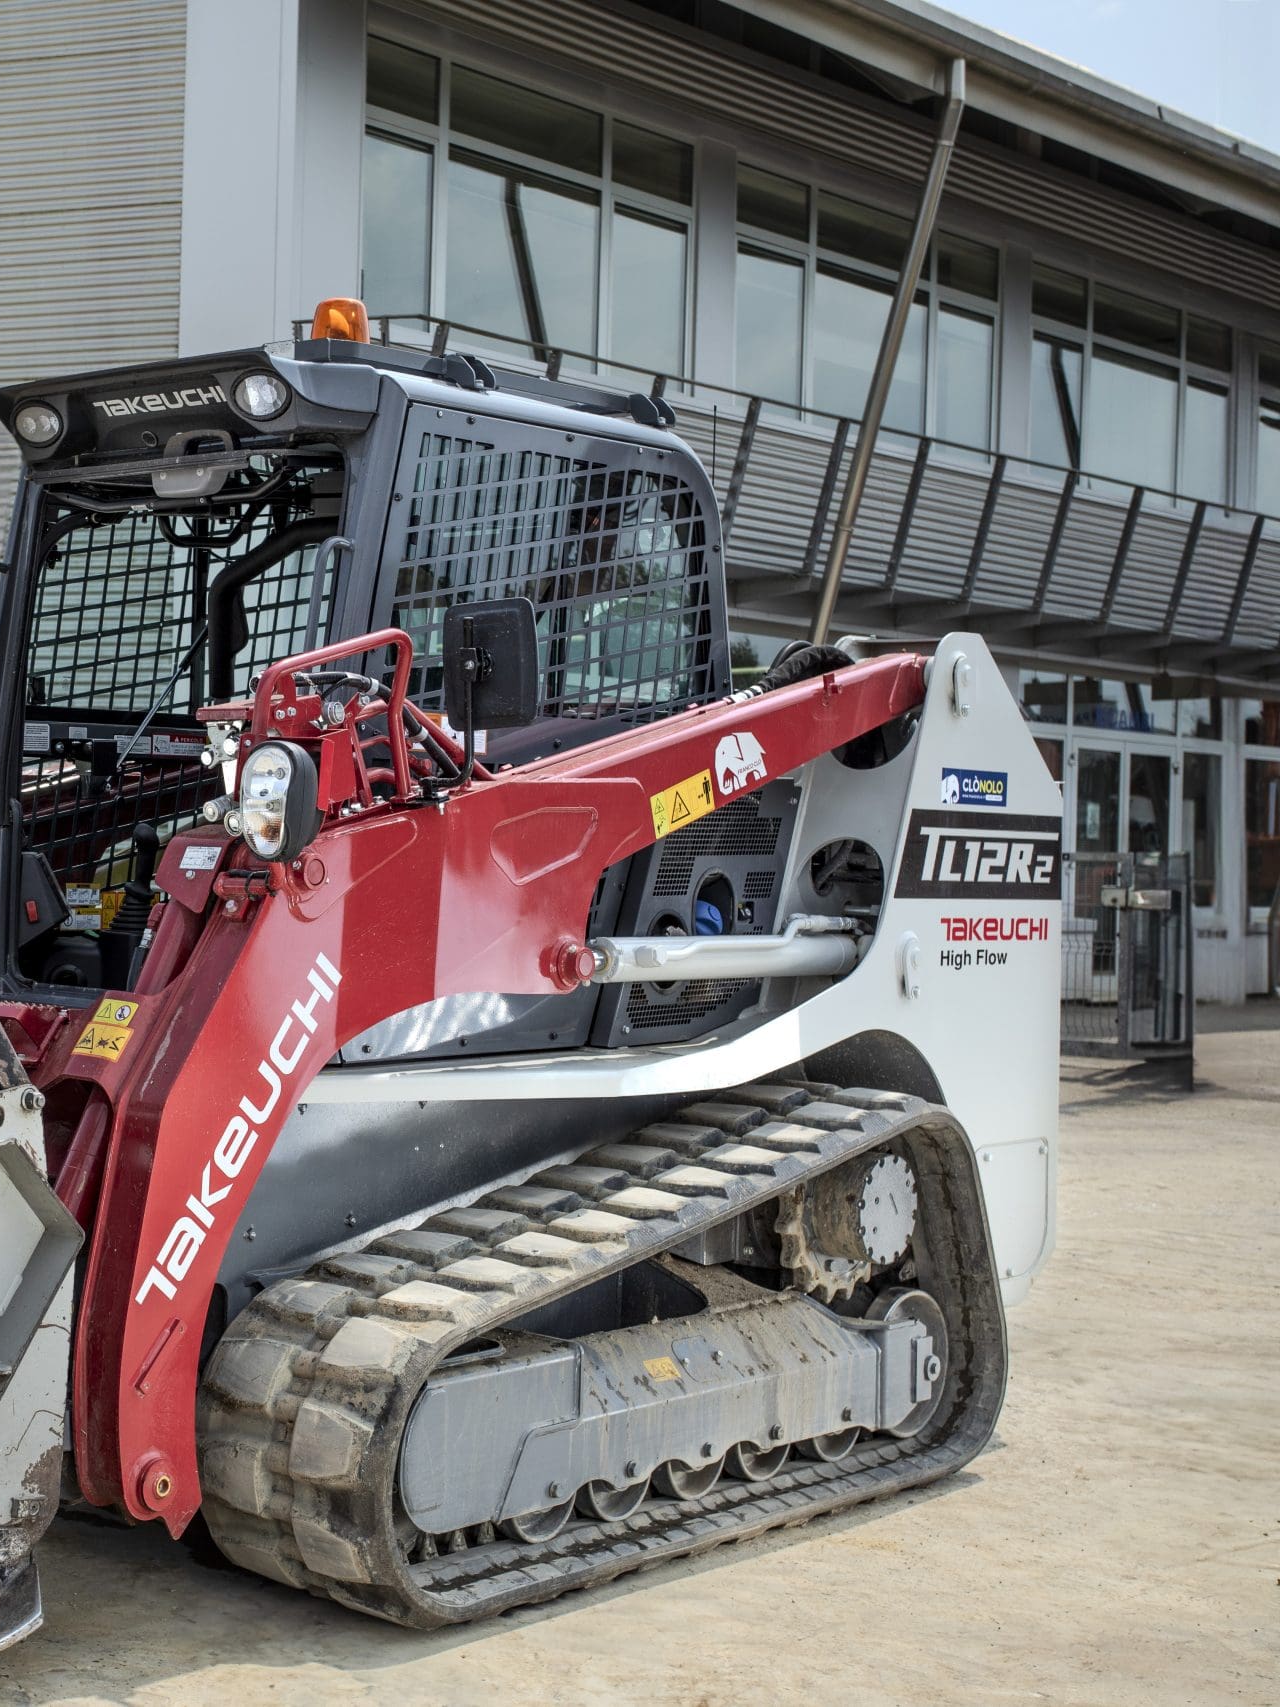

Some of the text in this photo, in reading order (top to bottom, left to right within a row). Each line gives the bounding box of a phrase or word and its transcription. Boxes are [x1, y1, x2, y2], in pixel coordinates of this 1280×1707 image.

[92, 384, 227, 418] TAKEUCHI
[962, 775, 1004, 794] CLÒNOLO
[940, 918, 1049, 941] TAKEUCHI
[940, 949, 1008, 970] High Flow
[134, 951, 343, 1305] TAKEUCHI
